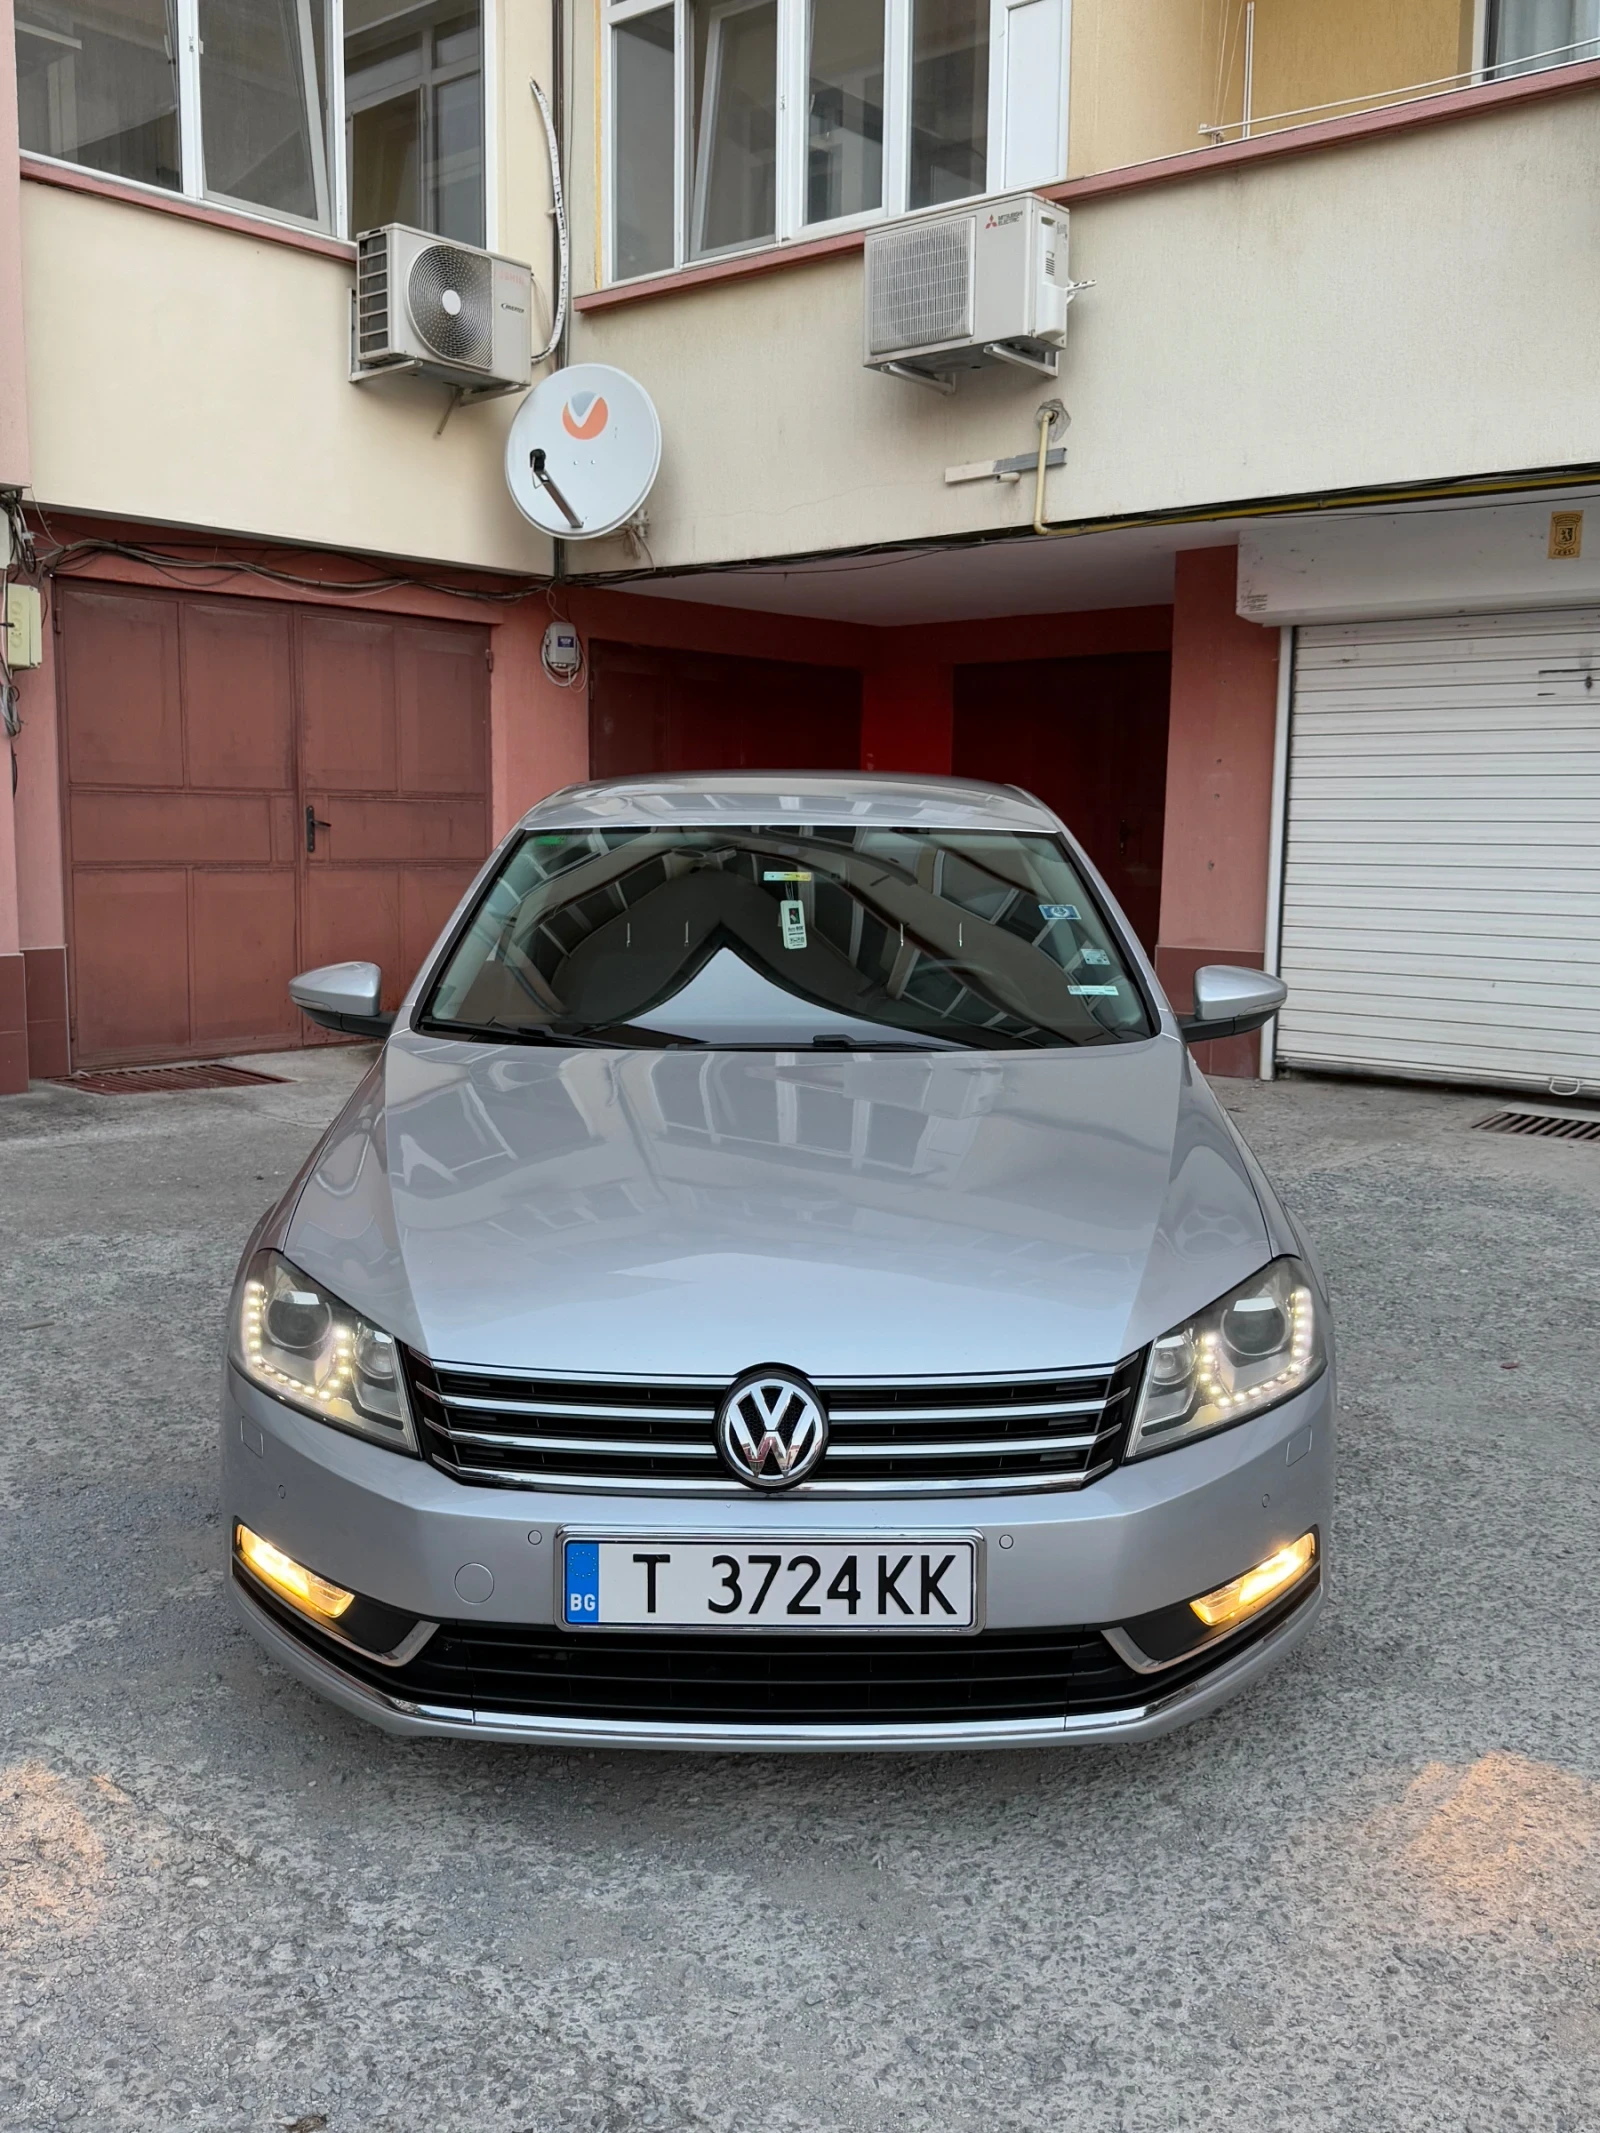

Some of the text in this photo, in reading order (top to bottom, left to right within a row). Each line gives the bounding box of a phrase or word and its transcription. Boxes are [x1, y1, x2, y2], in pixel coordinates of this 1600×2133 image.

[724, 1378, 823, 1480] VW
[570, 1593, 596, 1611] BG
[633, 1554, 671, 1613] T
